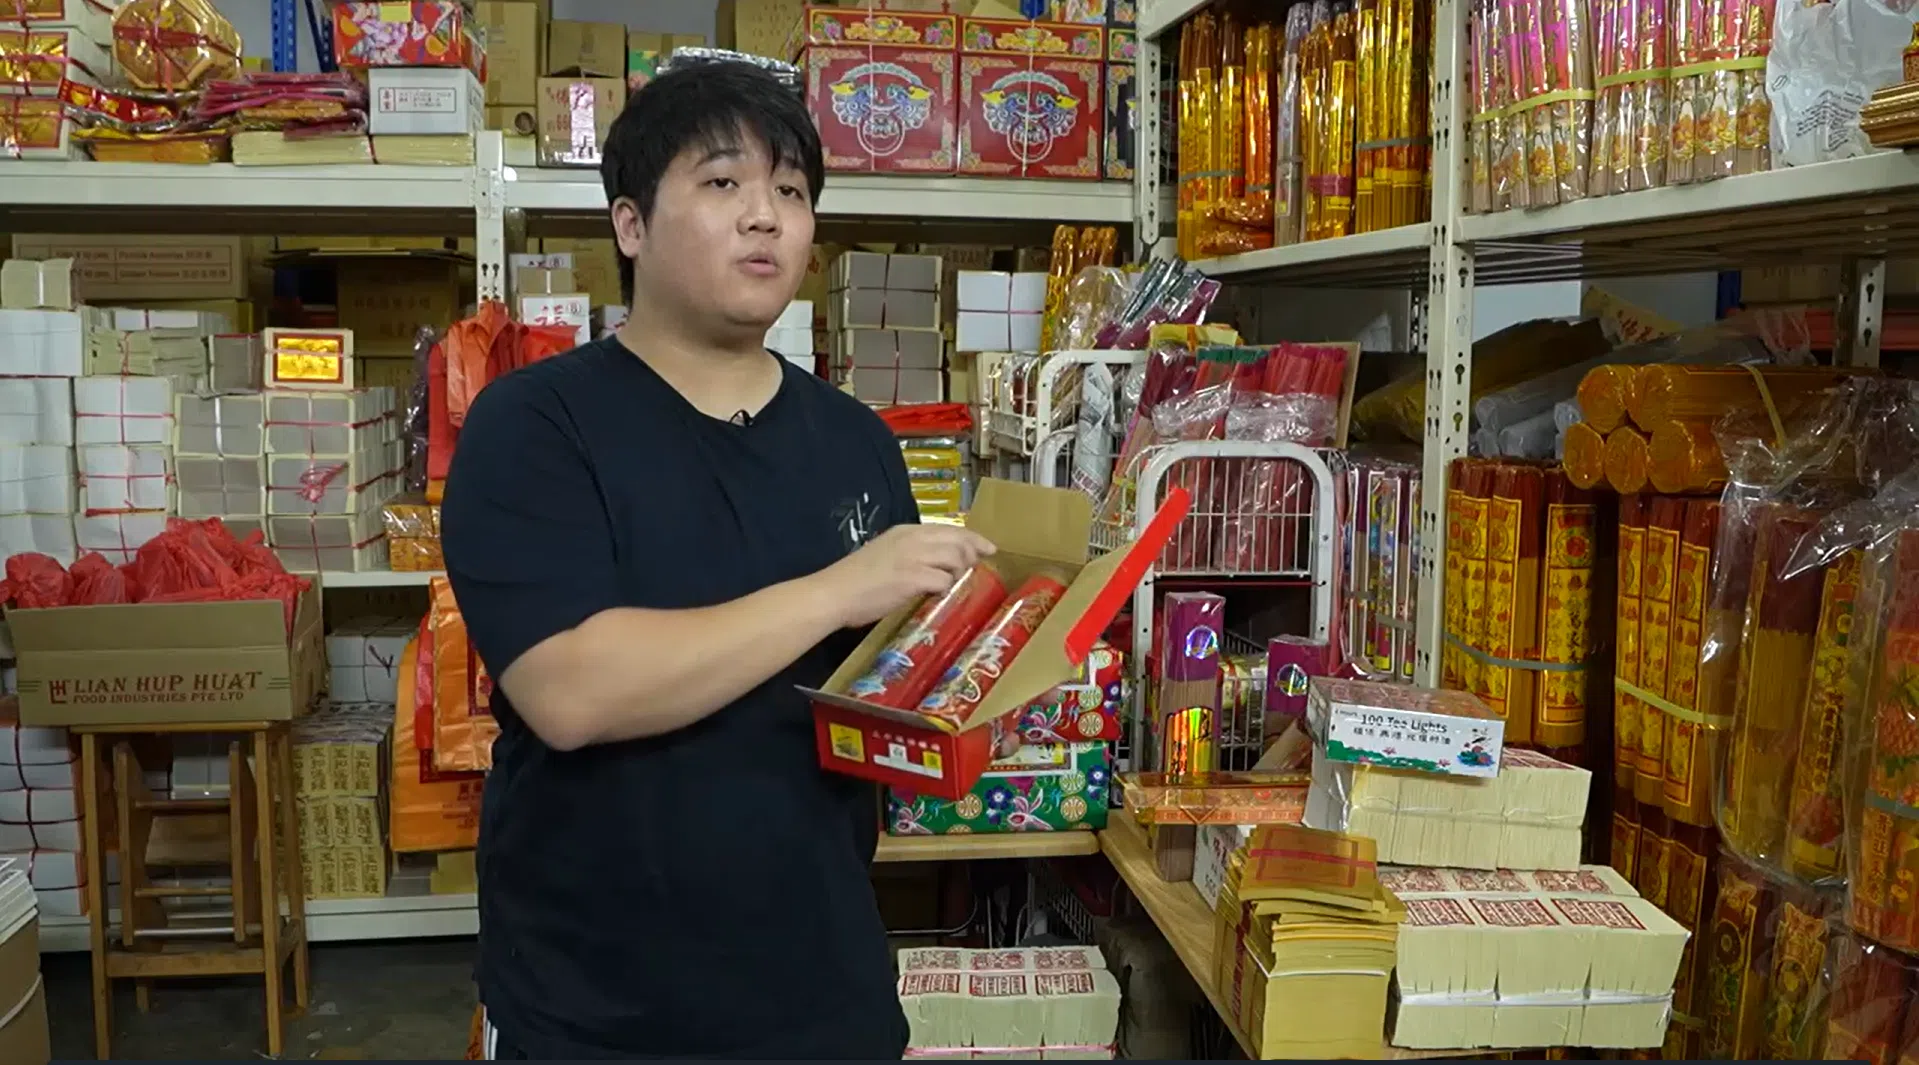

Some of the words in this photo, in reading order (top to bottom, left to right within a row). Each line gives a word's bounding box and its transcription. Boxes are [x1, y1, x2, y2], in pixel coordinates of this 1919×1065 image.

[75, 677, 127, 693] LIAN
[136, 675, 184, 692] HUP
[193, 671, 262, 690] HUAT
[73, 695, 107, 704] FOOD
[111, 692, 187, 703] INDUSTRIES
[190, 692, 216, 702] PTE
[220, 691, 244, 702] LTD
[1361, 714, 1384, 726] 100
[1387, 716, 1408, 729] Tea
[1411, 719, 1448, 733] Lights
